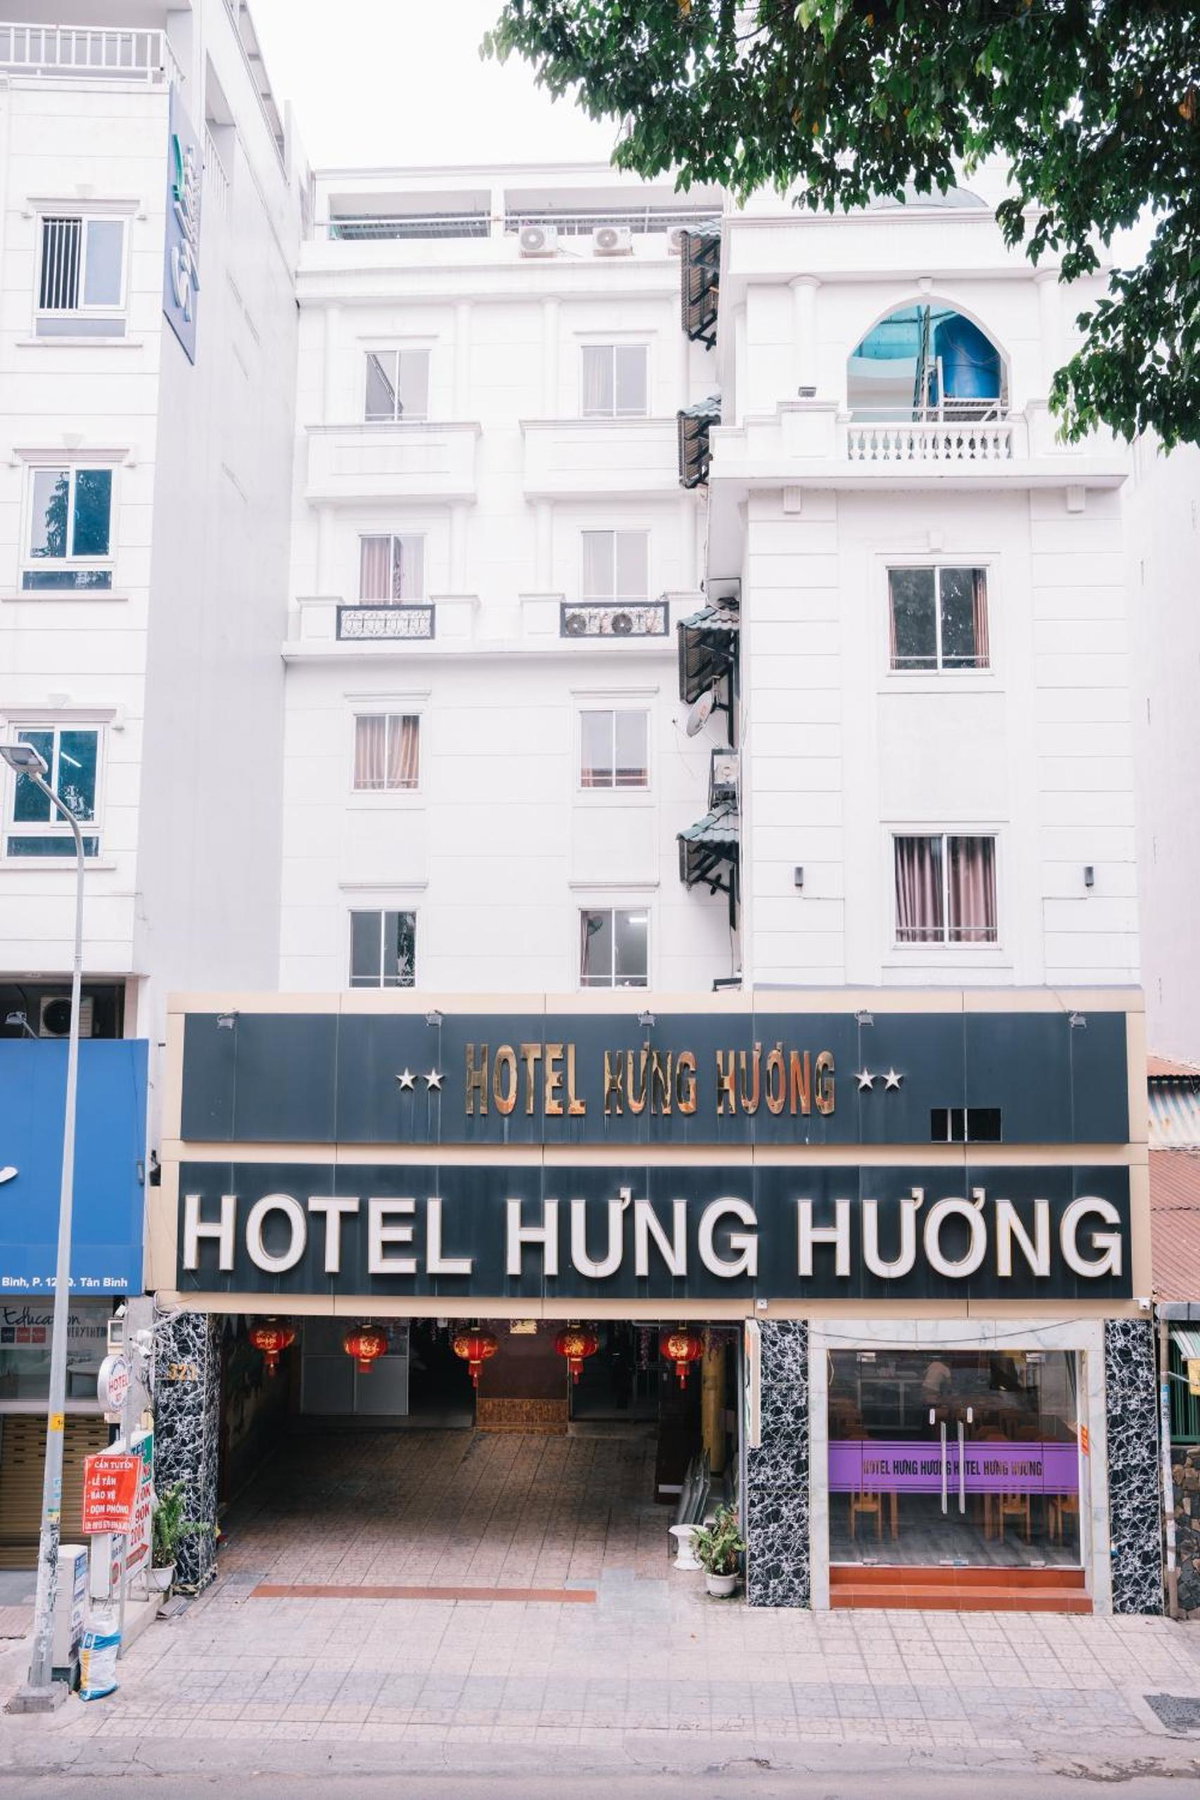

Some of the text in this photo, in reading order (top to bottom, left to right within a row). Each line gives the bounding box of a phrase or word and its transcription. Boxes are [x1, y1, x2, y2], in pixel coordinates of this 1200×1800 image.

[465, 1043, 587, 1115] HOTEL
[182, 1187, 1122, 1278] HOTEL HƯNG HƯƠNG
[32, 1277, 43, 1288] P.
